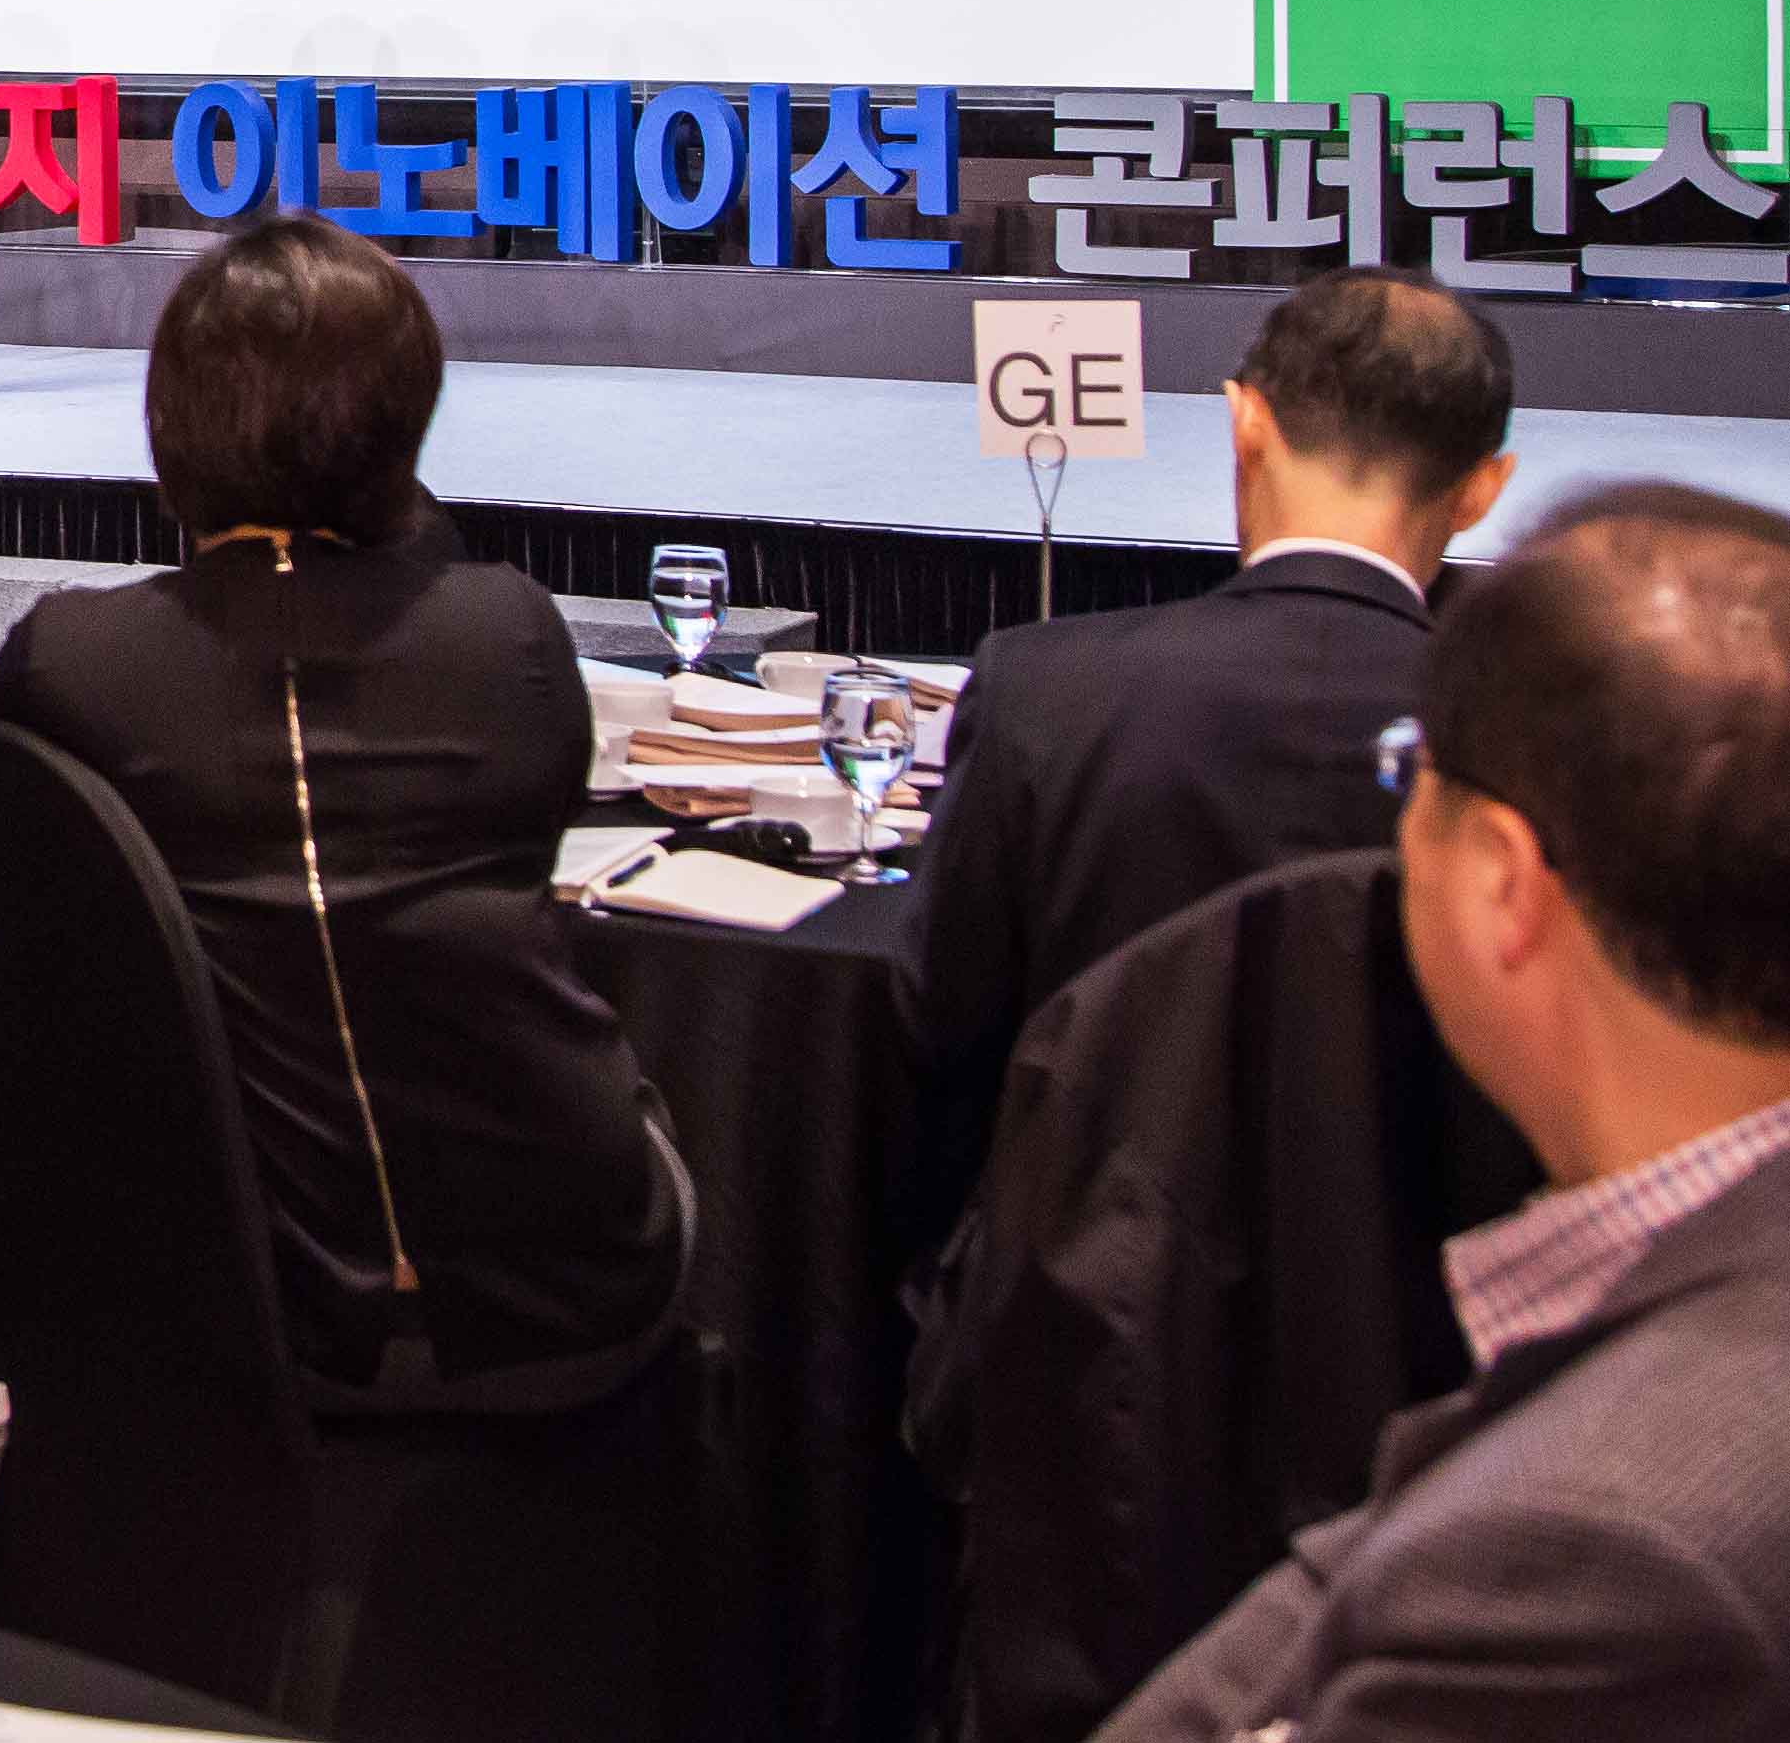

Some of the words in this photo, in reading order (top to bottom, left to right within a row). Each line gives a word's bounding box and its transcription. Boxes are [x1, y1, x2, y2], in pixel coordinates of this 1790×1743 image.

[172, 76, 962, 269] 이노베이션
[1028, 93, 1790, 293] 콘퍼런스
[987, 352, 1128, 429] GE
